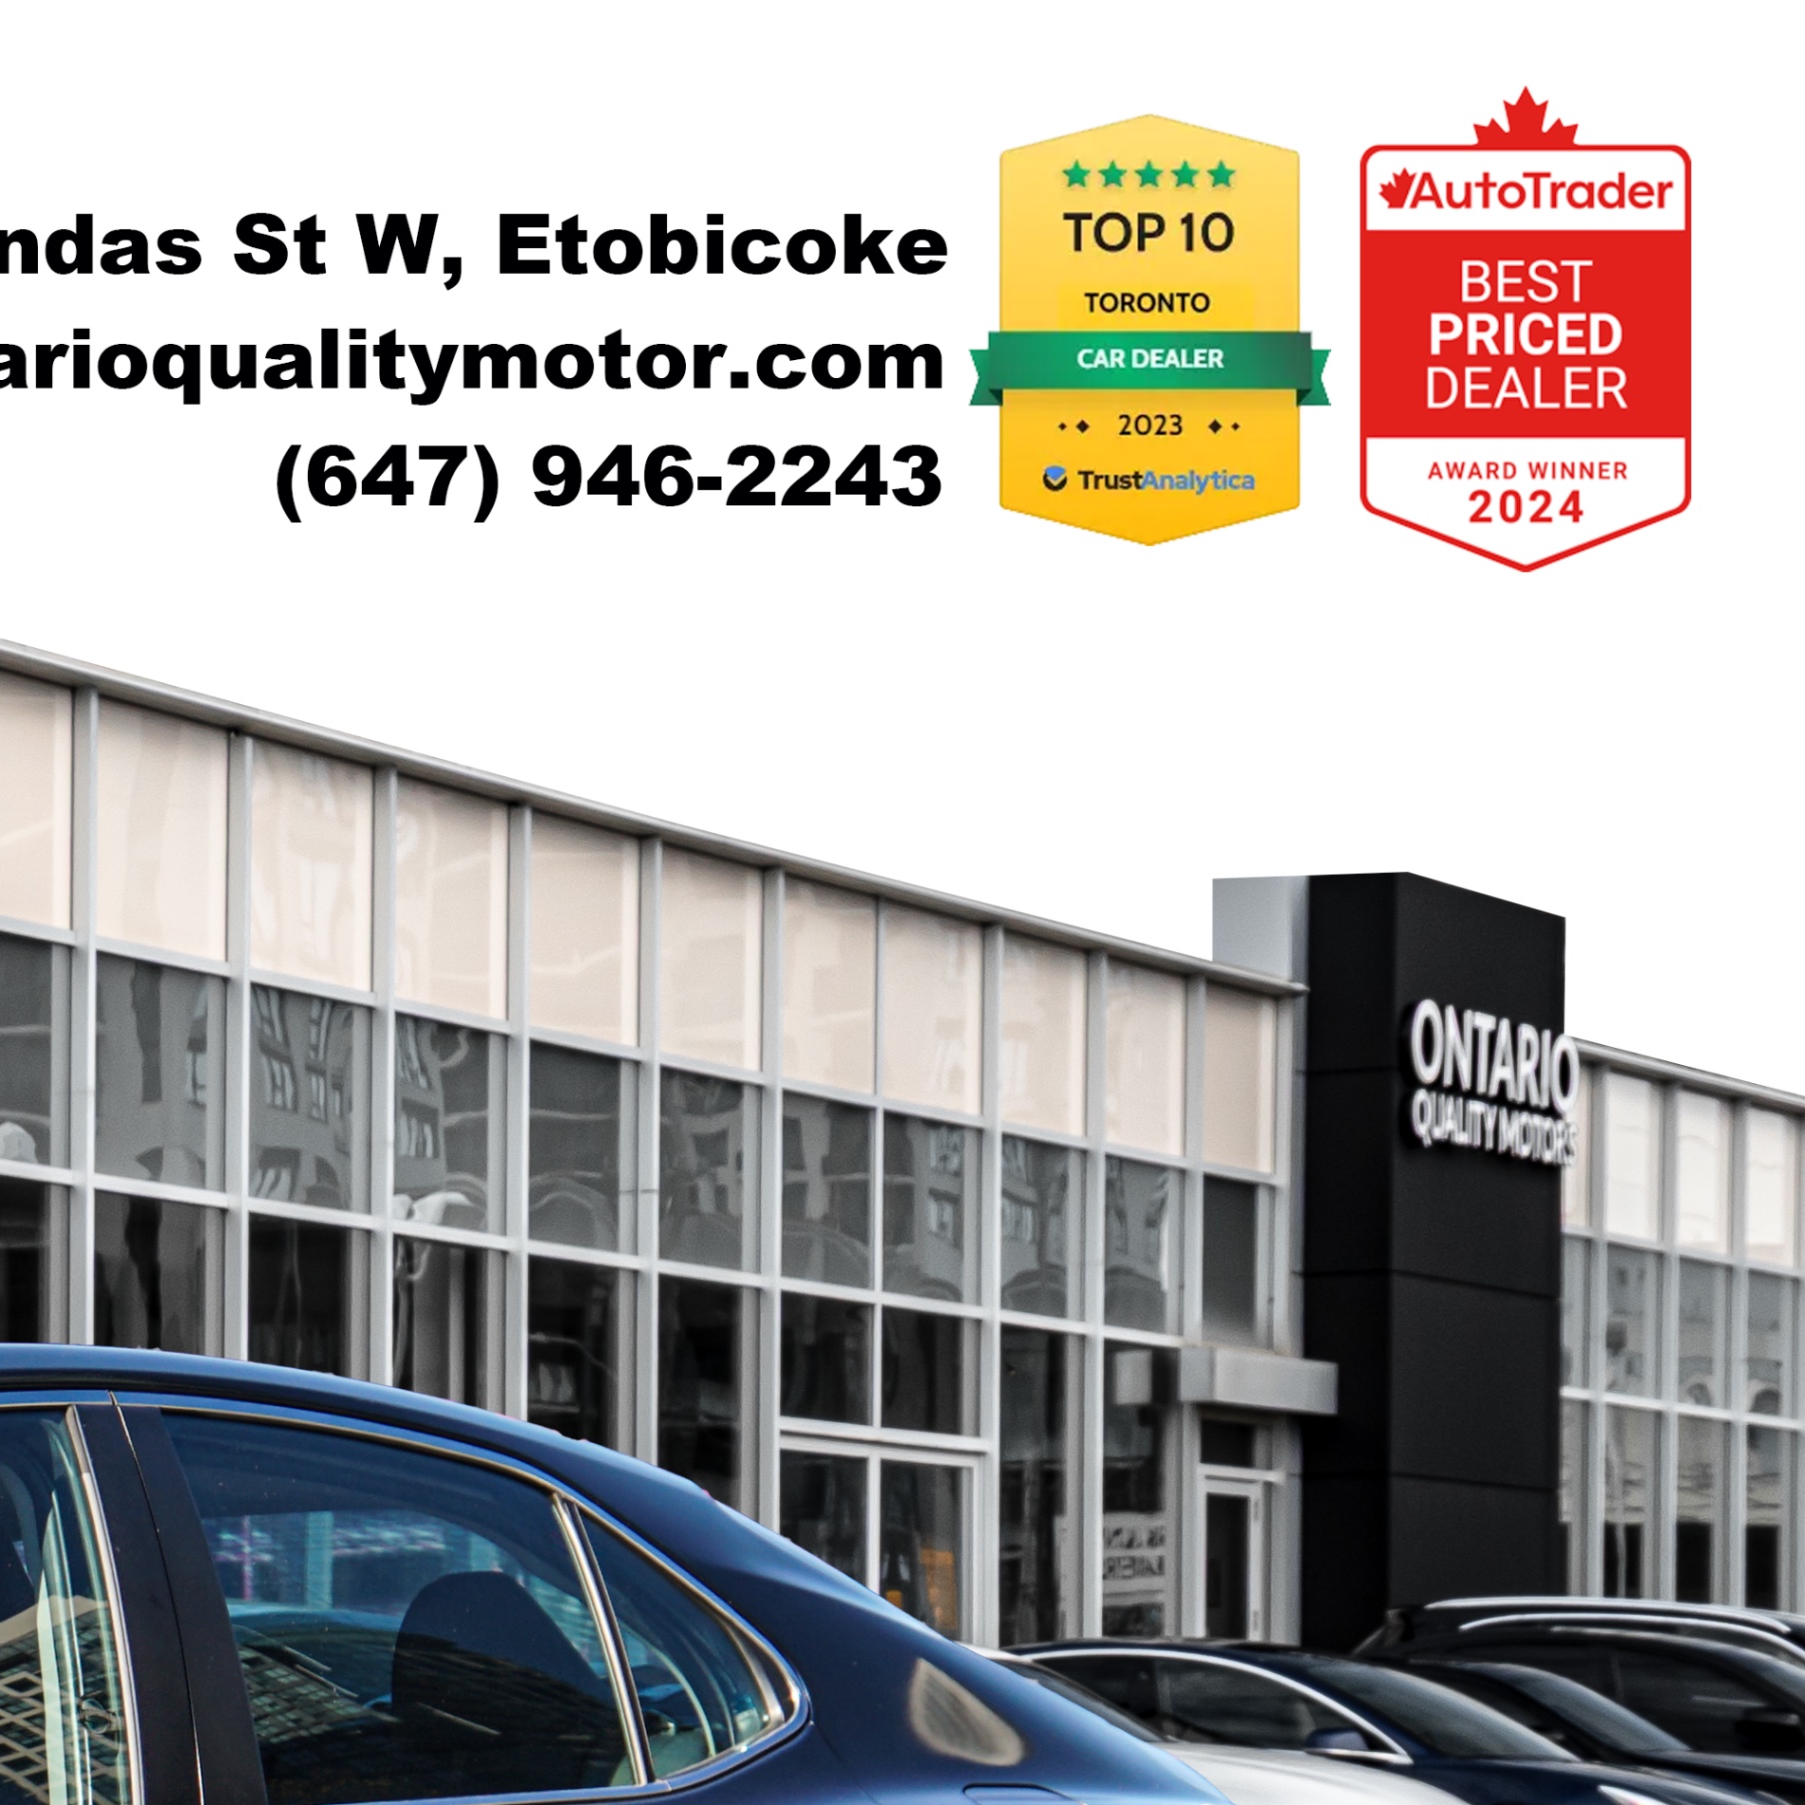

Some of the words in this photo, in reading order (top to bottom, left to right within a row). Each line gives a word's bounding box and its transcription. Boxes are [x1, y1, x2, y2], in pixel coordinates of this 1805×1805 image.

[1411, 998, 1580, 1115] ONTARIO
[1412, 1088, 1497, 1151] QUALITY
[1498, 1106, 1578, 1166] MOTORS
